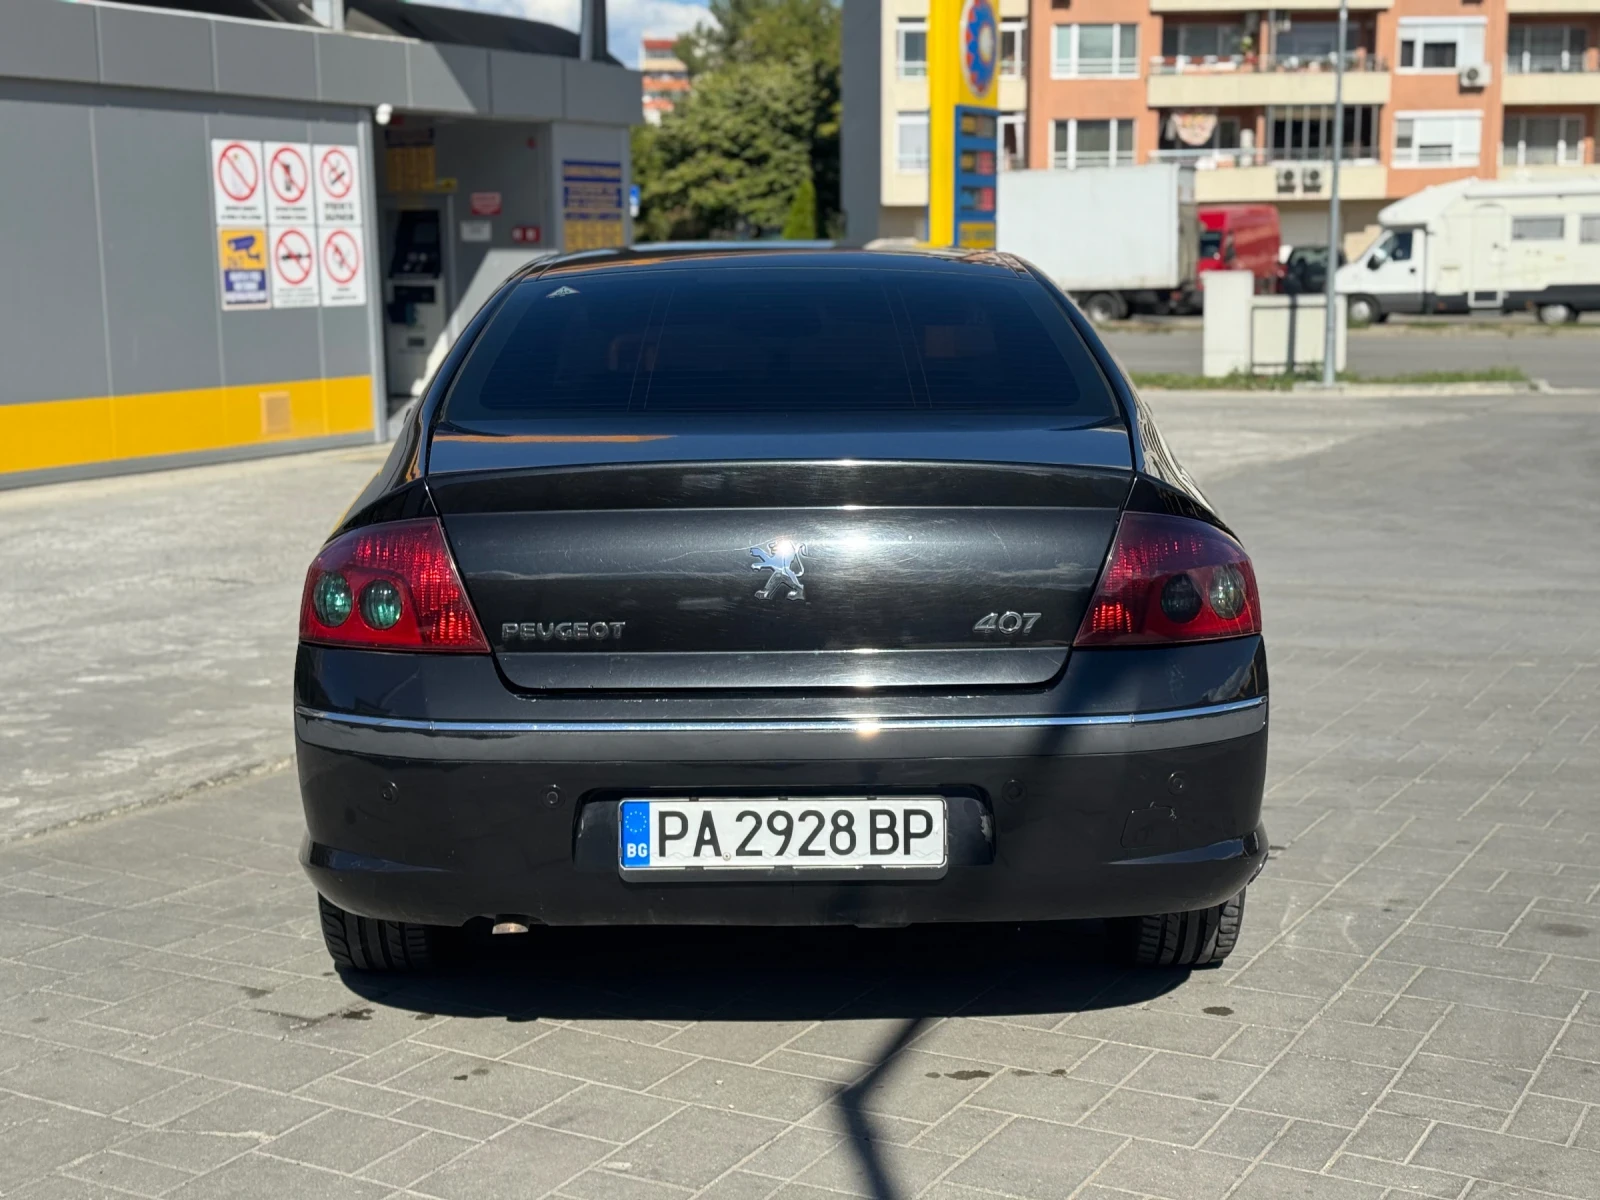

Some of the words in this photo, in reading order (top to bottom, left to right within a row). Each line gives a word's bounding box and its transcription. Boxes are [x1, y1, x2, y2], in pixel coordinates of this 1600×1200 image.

[502, 621, 626, 640] PEUGEOT
[972, 611, 1042, 634] 407
[658, 810, 722, 857] PA
[735, 809, 857, 857] 2928
[869, 808, 934, 855] BP
[627, 842, 648, 858] BG
